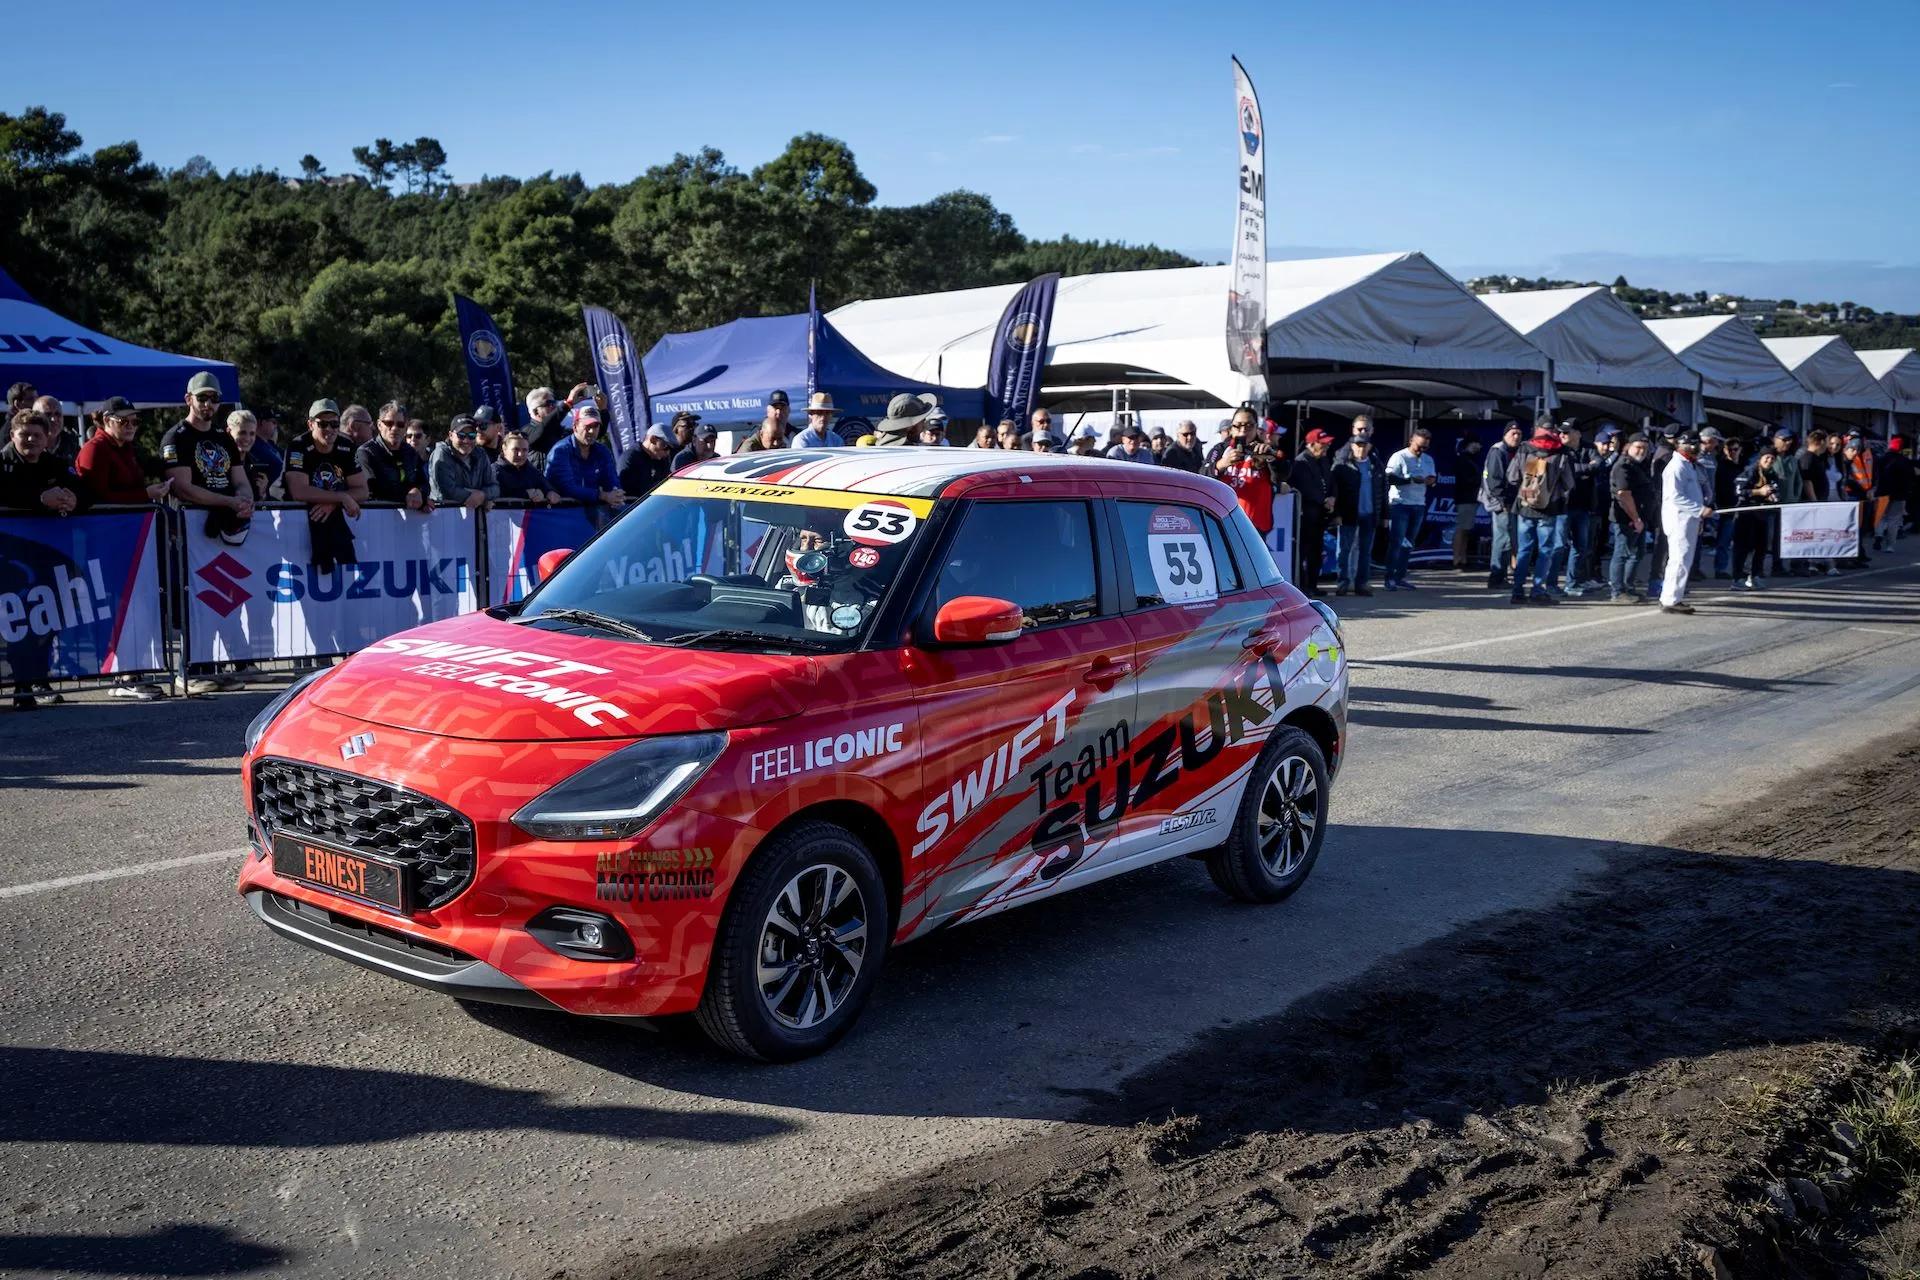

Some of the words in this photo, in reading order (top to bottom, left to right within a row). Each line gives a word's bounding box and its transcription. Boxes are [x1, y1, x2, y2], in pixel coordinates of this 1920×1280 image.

[610, 382, 625, 425] MOTOR
[704, 400, 730, 410] MOTOR
[732, 398, 761, 408] MUSEUM
[708, 485, 795, 497] DUNLOP
[852, 510, 909, 535] 53
[266, 557, 467, 602] SUZUKI
[606, 538, 694, 589] Yeah!
[854, 552, 877, 565] 14C
[1163, 543, 1203, 586] 53
[370, 639, 613, 678] SWIFT
[401, 662, 479, 680] FEEL
[459, 671, 629, 728] ICONIC
[751, 745, 801, 784] FEEL
[805, 723, 904, 770] ICONIC
[912, 688, 1077, 858] SWIFT
[1031, 652, 1286, 880] SUZUKI
[1031, 719, 1130, 815] Team
[1159, 808, 1216, 835] ECSTAR
[305, 846, 367, 895] ERNEST
[597, 851, 623, 871] ALL
[630, 850, 681, 871] THINGS
[597, 868, 715, 902] MOTORING
